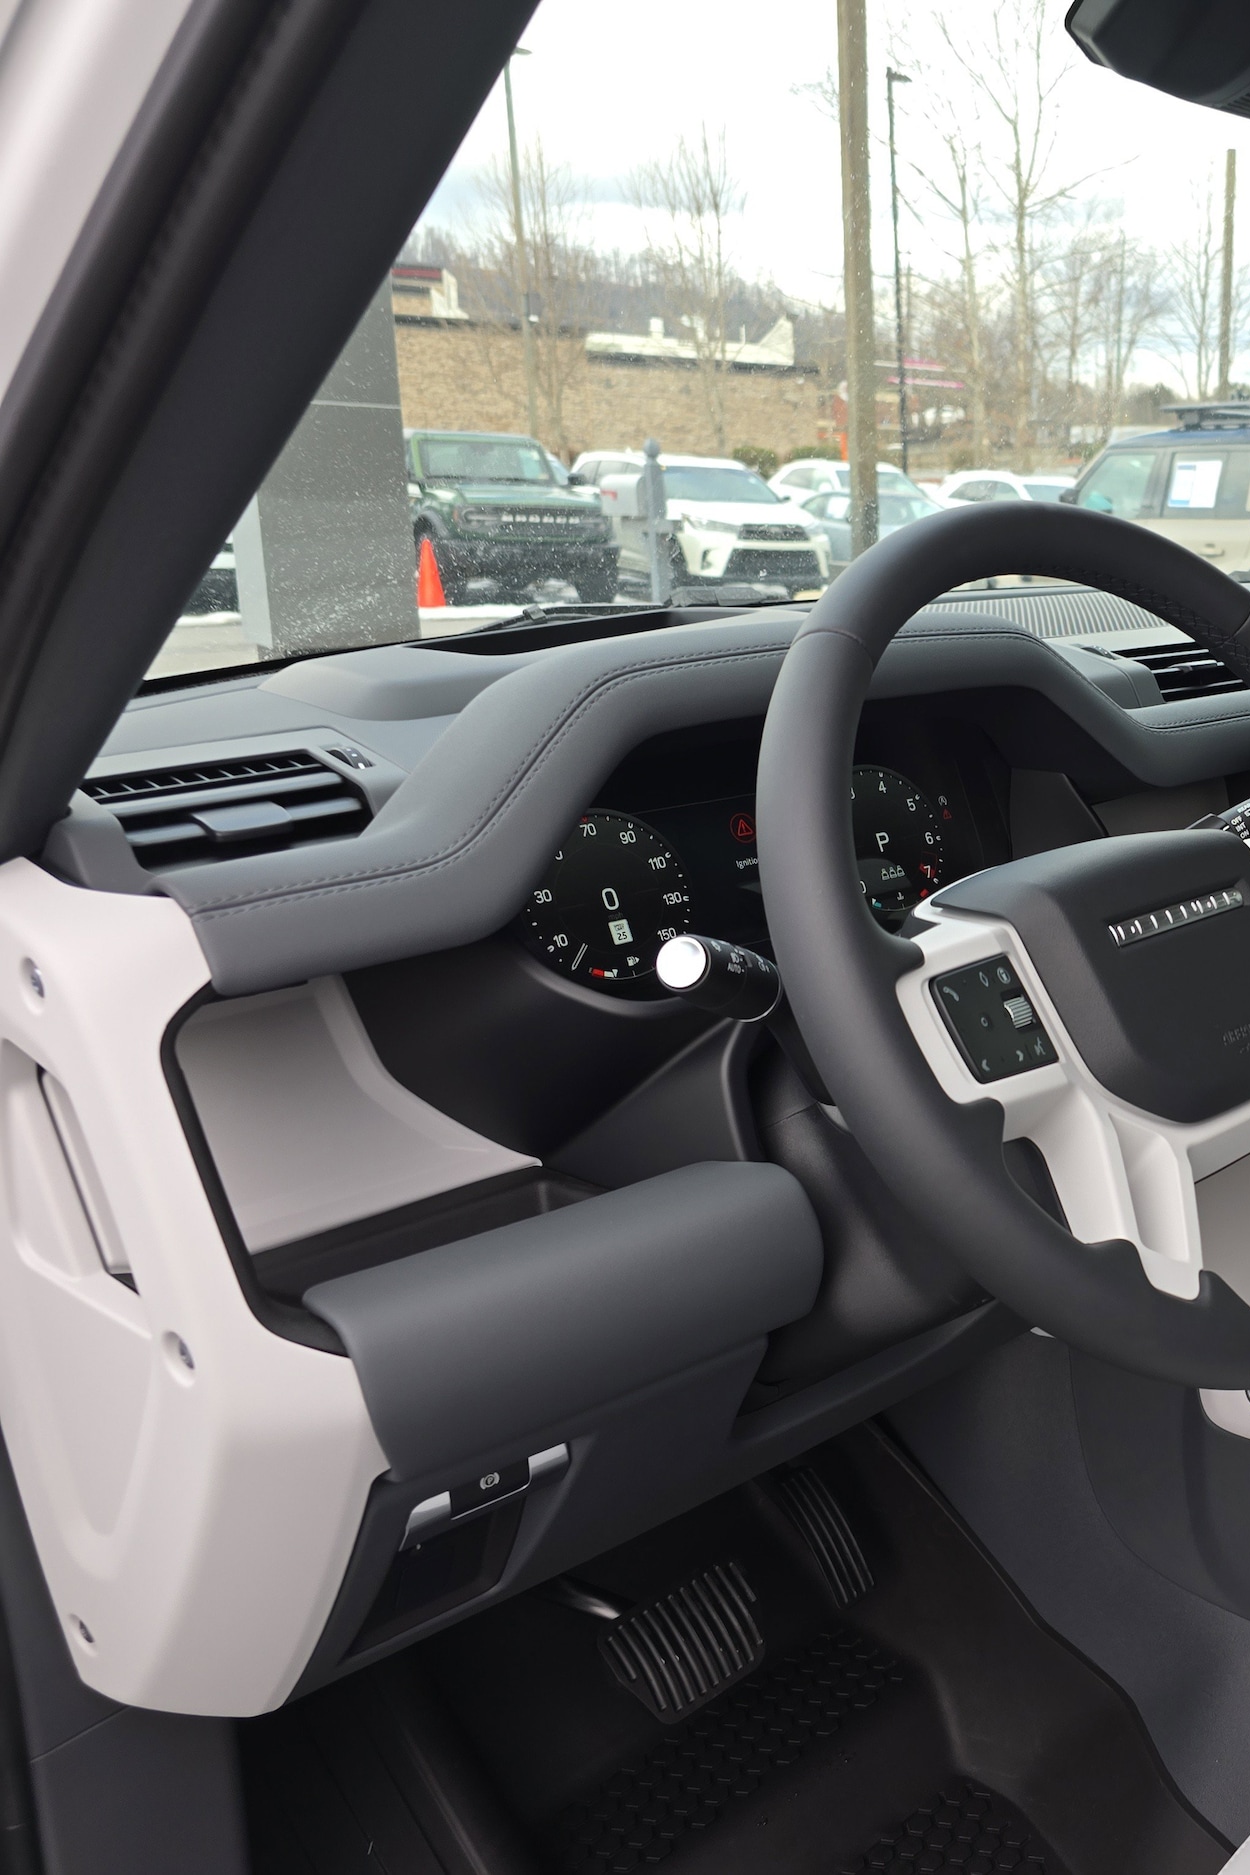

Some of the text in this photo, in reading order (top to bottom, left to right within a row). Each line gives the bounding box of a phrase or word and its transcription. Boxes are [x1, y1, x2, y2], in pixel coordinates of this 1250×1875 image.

[878, 780, 887, 794] 4
[906, 798, 917, 812] 5
[1231, 815, 1243, 826] OFF
[1235, 821, 1247, 833] INT
[580, 823, 597, 837] 70
[1240, 829, 1250, 839] ON
[619, 830, 636, 845] 90
[875, 832, 889, 853] P
[924, 831, 934, 845] 6
[648, 856, 667, 870] 110
[735, 856, 758, 870] Ignitio
[923, 865, 931, 879] 7
[533, 889, 552, 904] 30
[601, 887, 620, 911] 0
[662, 891, 682, 905] 130
[553, 933, 569, 948] 10
[617, 931, 628, 941] 25
[657, 927, 677, 942] 150
